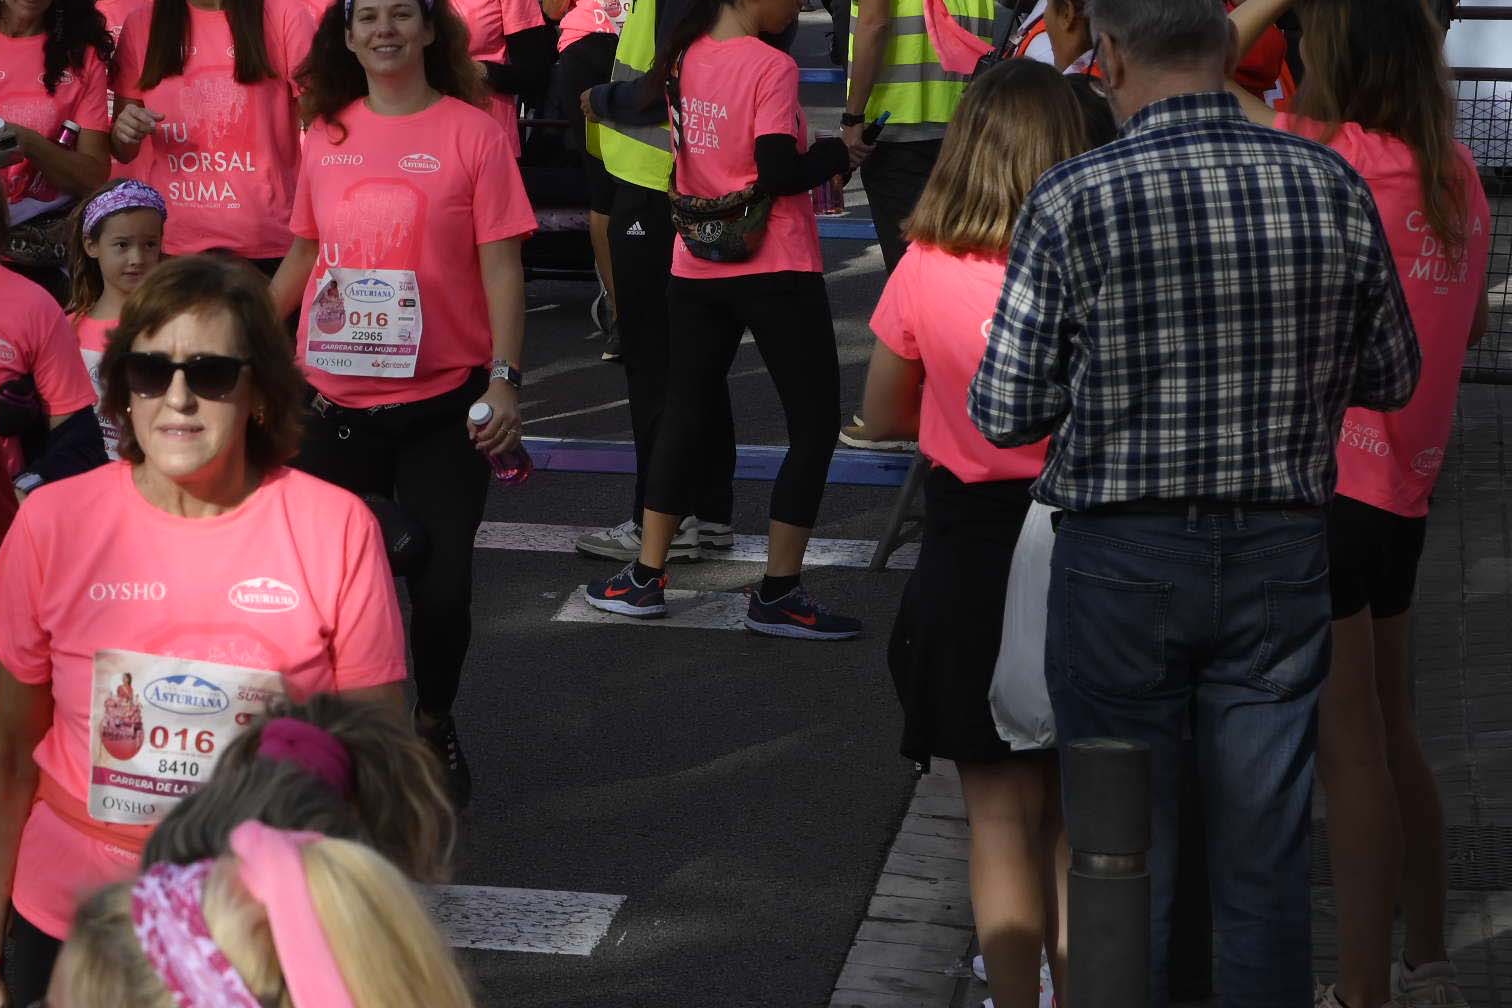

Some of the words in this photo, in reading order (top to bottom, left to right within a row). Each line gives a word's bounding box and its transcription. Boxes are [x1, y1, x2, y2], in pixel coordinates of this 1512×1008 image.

[161, 122, 188, 144] TU
[702, 118, 717, 133] LA
[168, 151, 255, 173] DORSAL
[321, 154, 364, 167] OYSHO
[169, 180, 237, 202] SUMA
[349, 311, 389, 327] 016
[351, 331, 383, 342] 22965
[321, 343, 352, 351] CARRERA
[316, 357, 352, 368] OYSHO
[89, 581, 167, 602] OYSHO
[233, 589, 297, 607] ASTURIANA
[149, 686, 222, 709] ASTURIANA
[149, 726, 216, 754] 016
[158, 758, 199, 777] 8410
[109, 774, 154, 790] CARRERA
[156, 782, 172, 792] DE
[174, 785, 189, 794] LA
[102, 795, 155, 815] OYSHO
